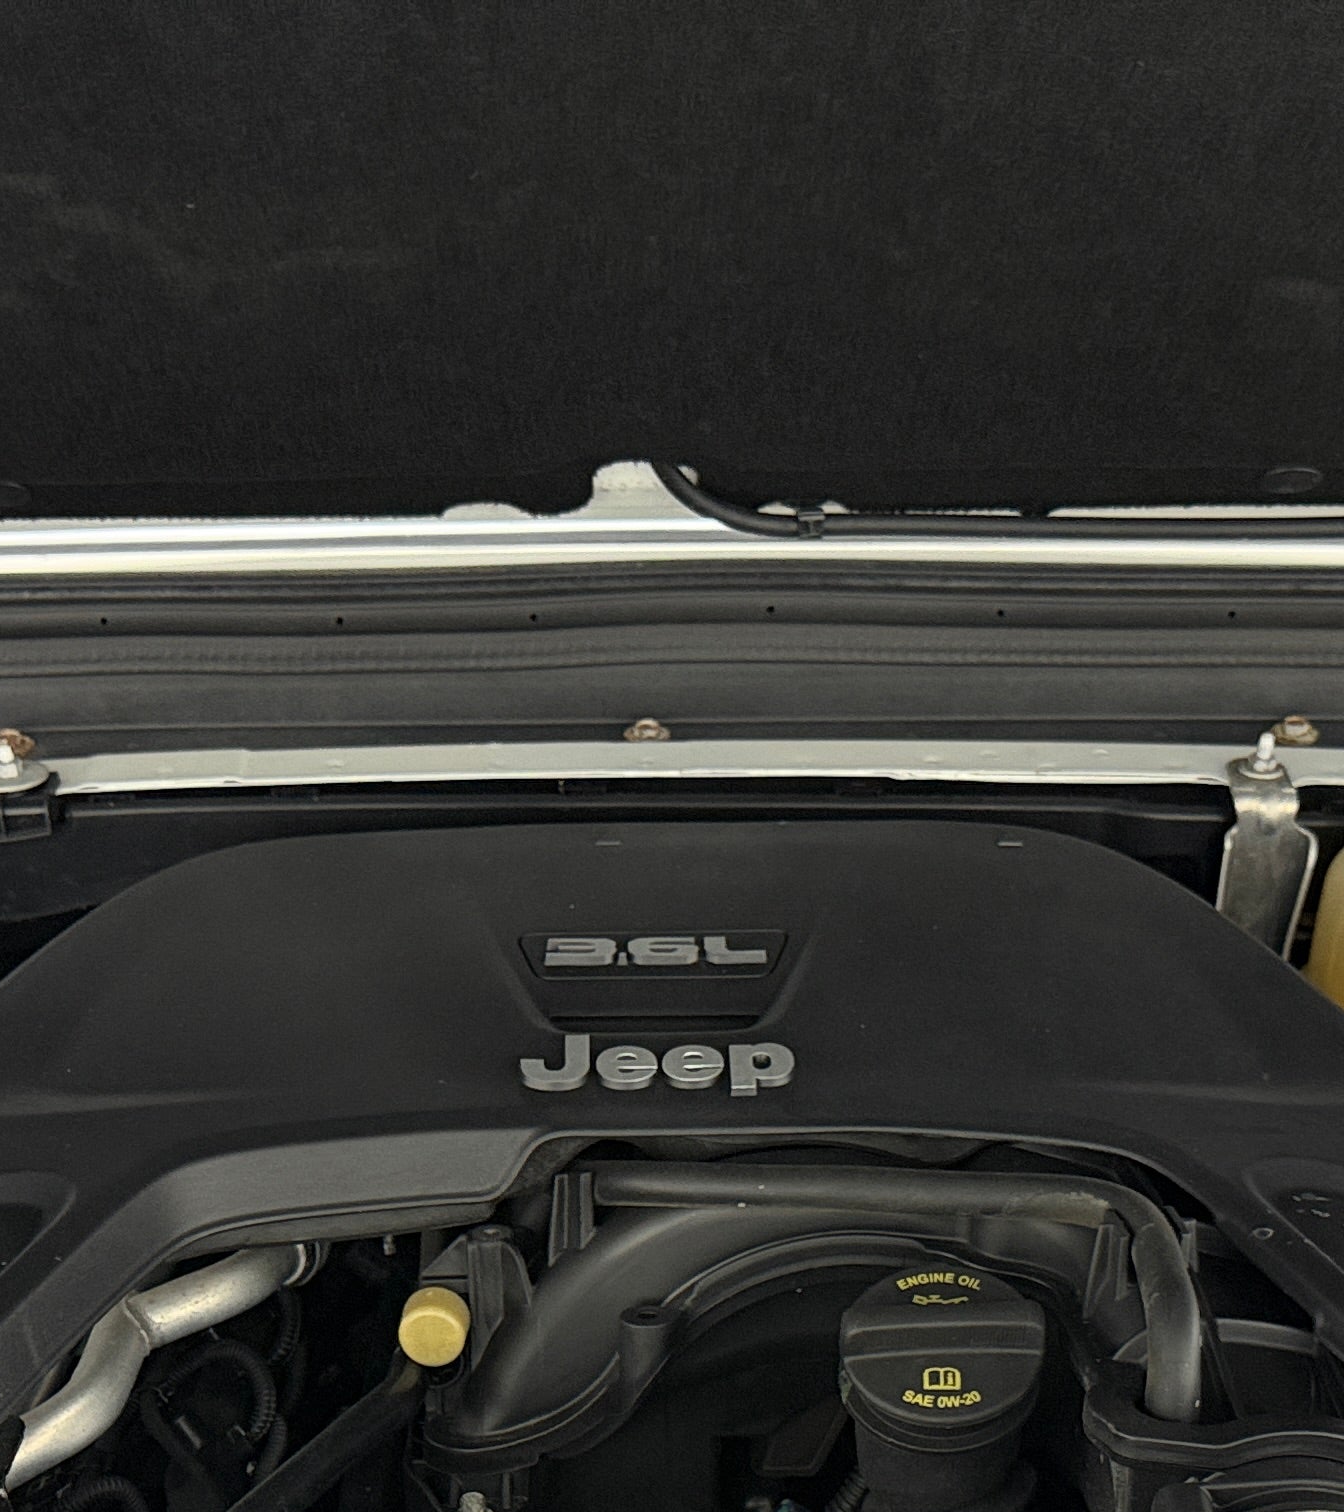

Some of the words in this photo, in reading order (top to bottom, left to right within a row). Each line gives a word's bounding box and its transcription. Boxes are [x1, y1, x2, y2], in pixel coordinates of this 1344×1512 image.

[544, 936, 768, 967] 3.6L
[519, 1034, 795, 1096] Jeep
[896, 1272, 954, 1291] ENGINE
[958, 1275, 982, 1291] OIL
[902, 1390, 935, 1408] SAE
[937, 1391, 981, 1408] 0W-20
